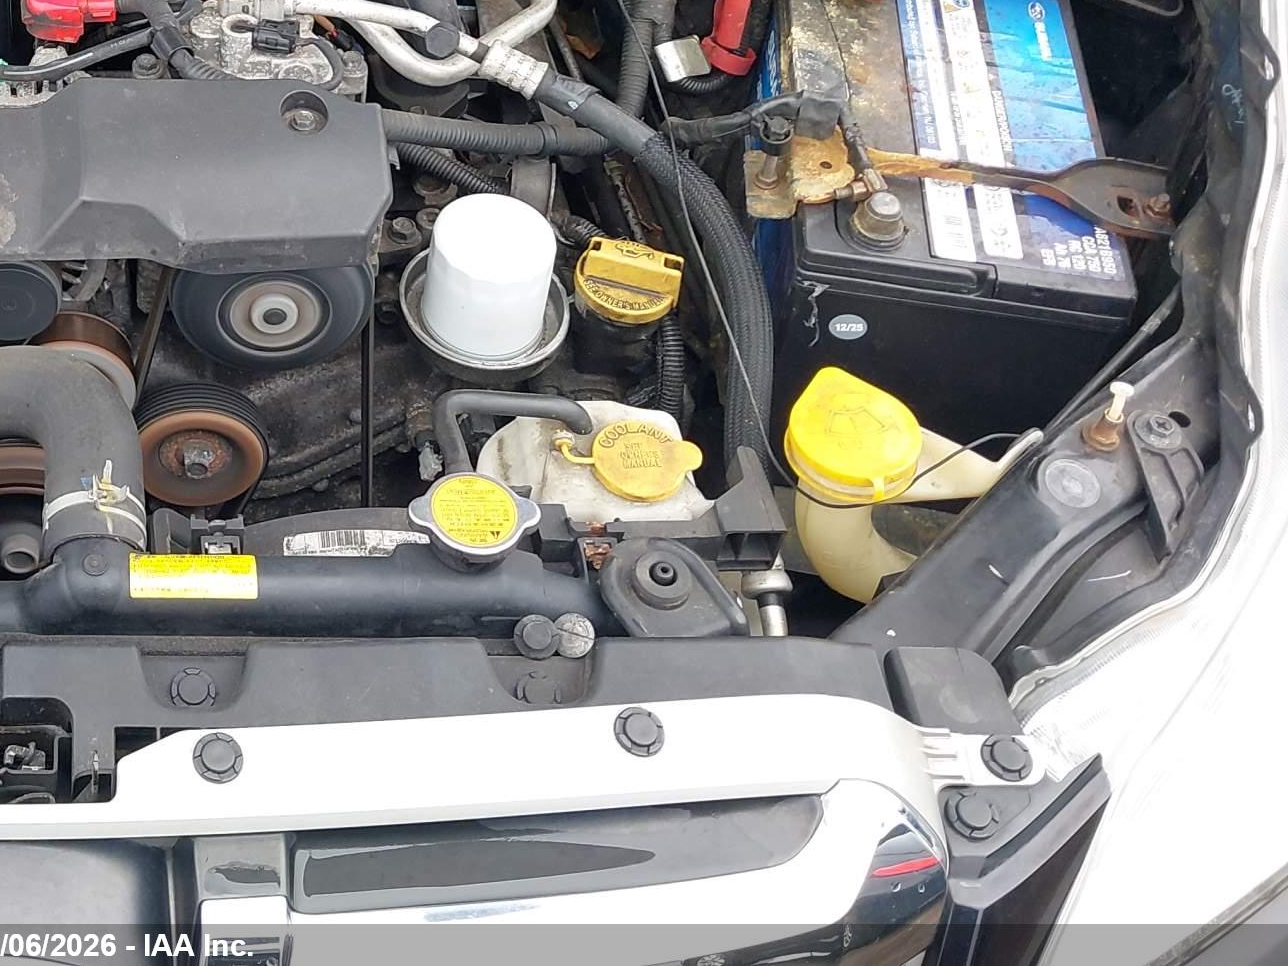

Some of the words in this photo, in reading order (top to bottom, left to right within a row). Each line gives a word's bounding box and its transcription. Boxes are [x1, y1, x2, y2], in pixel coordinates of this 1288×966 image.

[1081, 236, 1098, 254] CCA
[1086, 256, 1102, 272] 750
[583, 278, 600, 295] SEE
[632, 296, 665, 311] MANUAL
[834, 323, 864, 332] 12/25
[598, 422, 673, 449] COOLANT
